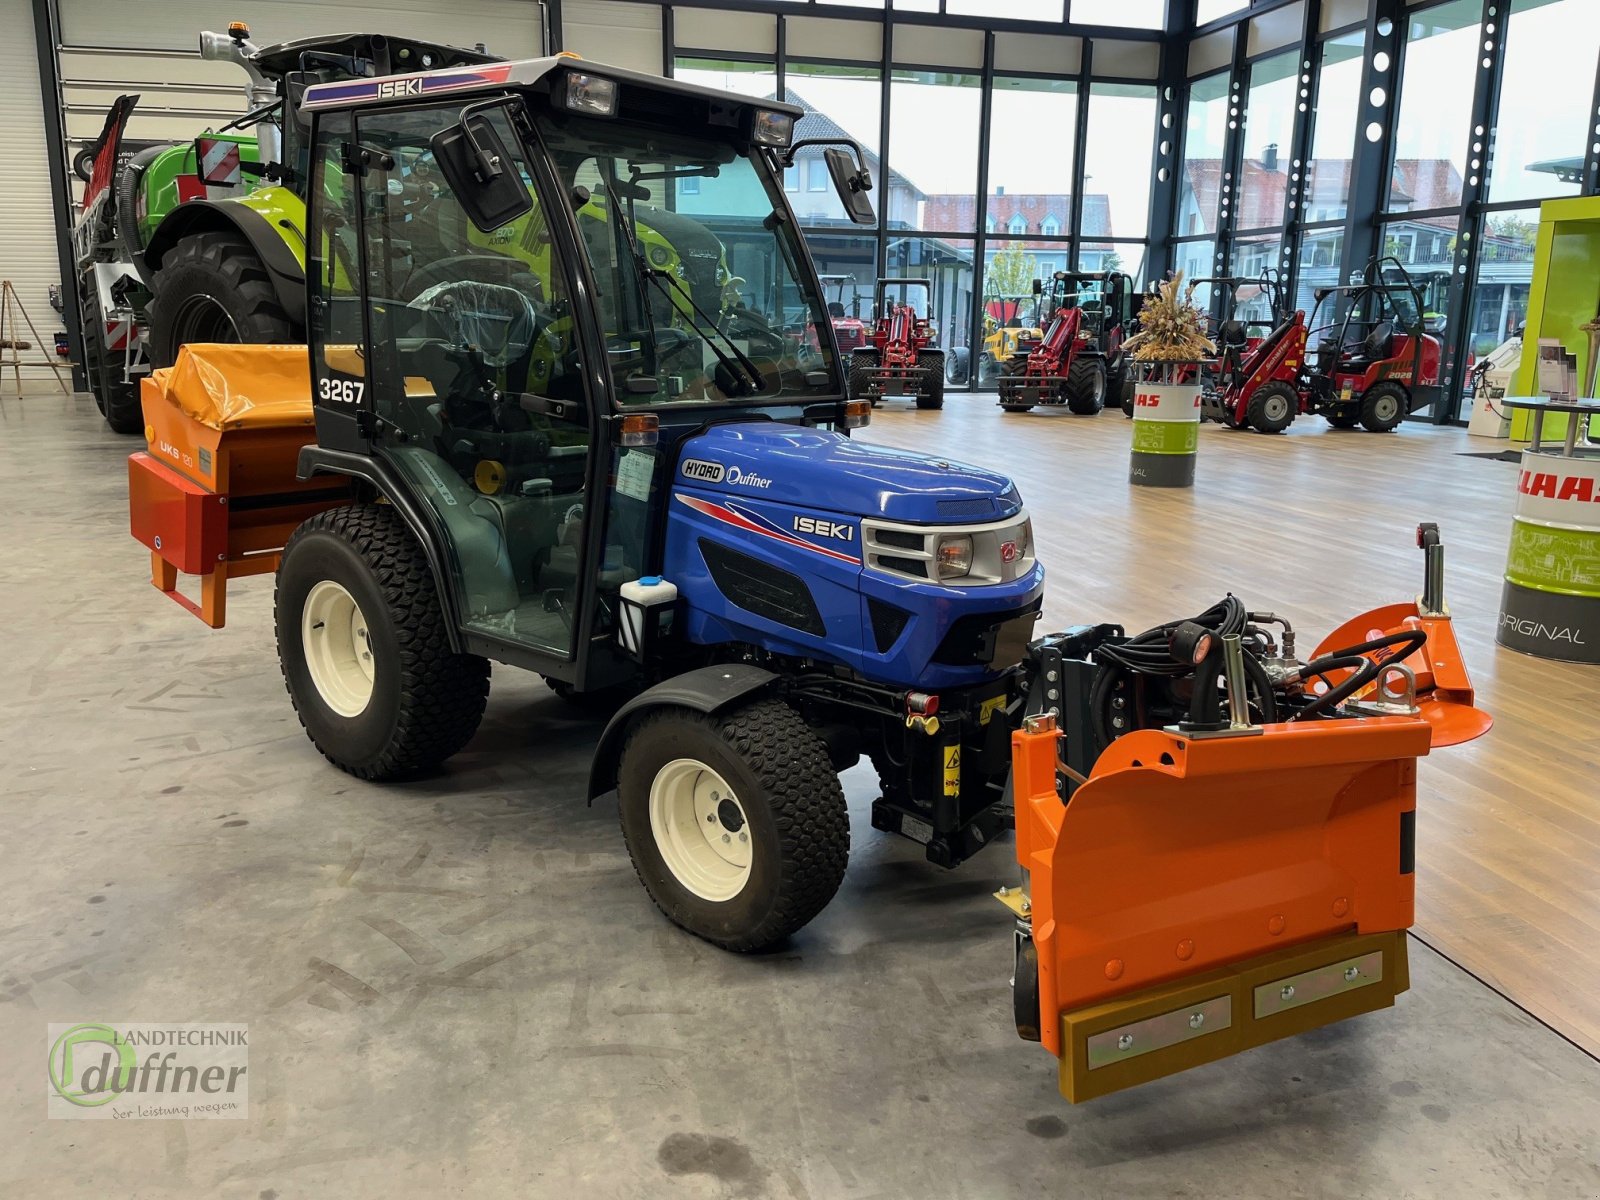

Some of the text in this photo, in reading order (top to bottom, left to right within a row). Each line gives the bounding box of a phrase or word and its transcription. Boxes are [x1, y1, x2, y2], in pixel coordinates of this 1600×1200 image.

[377, 78, 423, 99] ISEKI
[488, 236, 511, 245] AXION
[495, 227, 515, 237] 870
[319, 378, 365, 404] 3267
[1135, 394, 1160, 407] AS
[160, 440, 179, 459] UKS
[685, 462, 721, 480] HYDRO
[726, 466, 773, 489] Duffner
[1518, 469, 1600, 503] LAA
[793, 515, 854, 541] ISEKI
[1498, 611, 1586, 645] ORIGINAL
